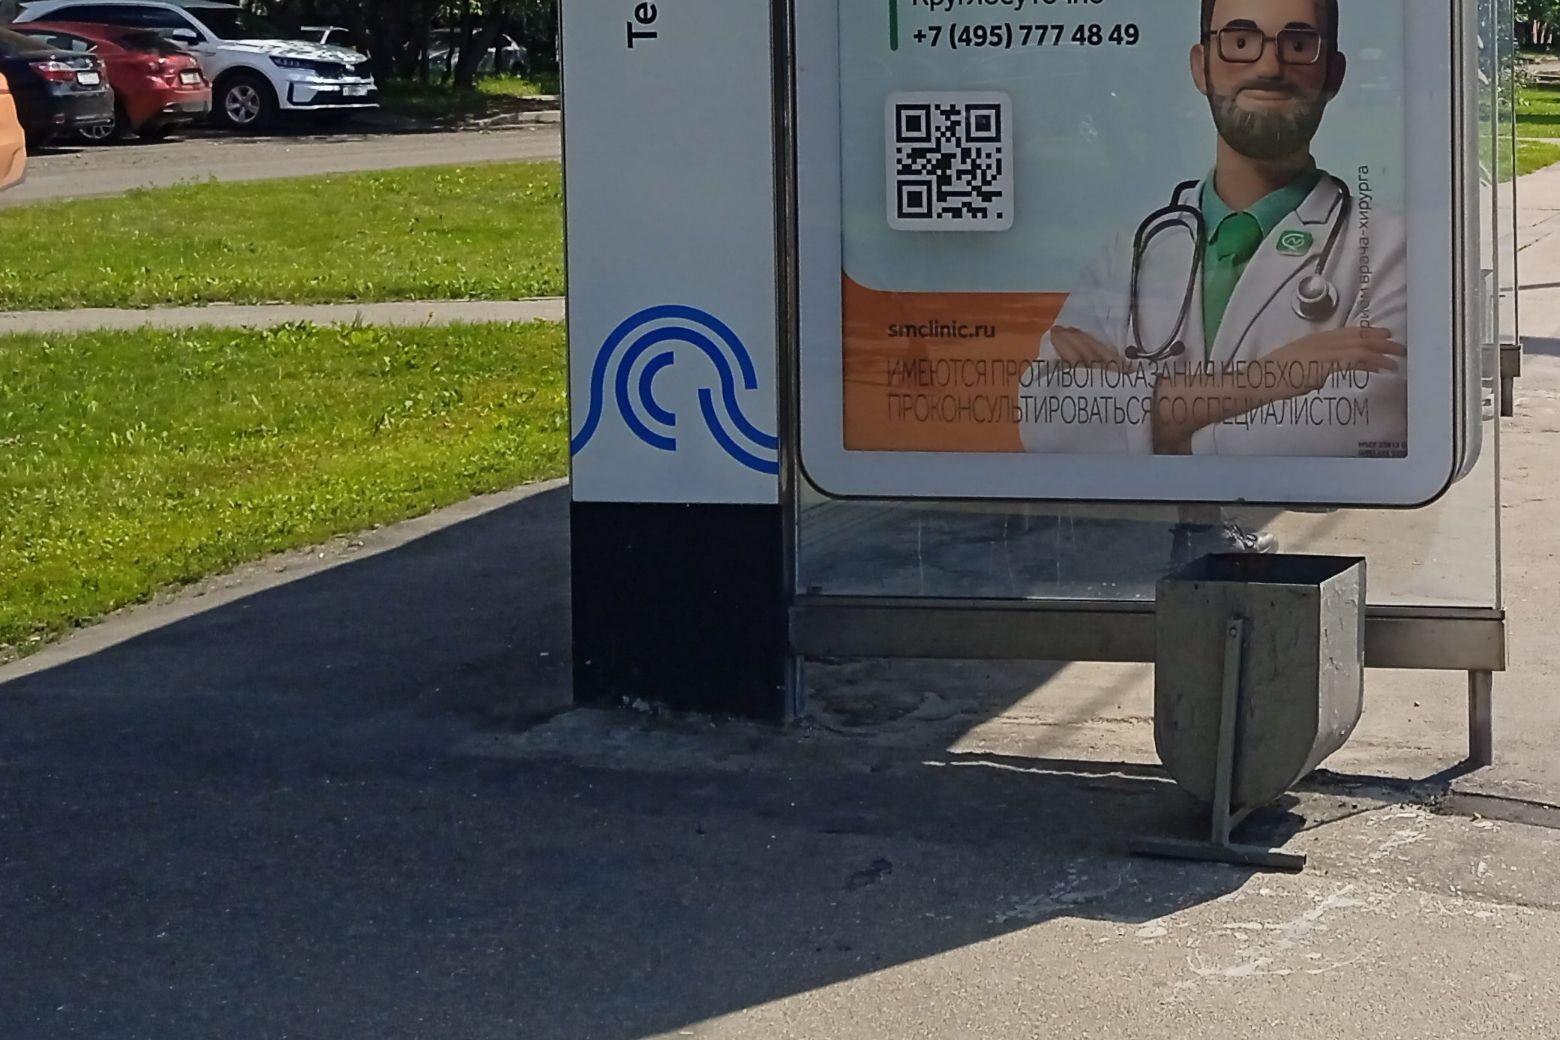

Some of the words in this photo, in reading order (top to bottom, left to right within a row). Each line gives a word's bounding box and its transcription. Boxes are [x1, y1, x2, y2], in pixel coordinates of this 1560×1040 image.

[913, 26, 942, 46] +7
[948, 23, 1014, 49] (495)
[1019, 24, 1064, 47] 777
[1071, 24, 1103, 46] 48
[1108, 24, 1140, 45] 49
[1358, 165, 1373, 284] врача-хирурга
[887, 320, 996, 342] smclinic.ru
[886, 359, 987, 388] ИМЕЮТСЯ
[886, 394, 1152, 425] ПРОКОНСУЛЬТИРОВАТЬСЯ
[1156, 396, 1188, 425] СО
[1191, 396, 1370, 431] СПЕЦИАЛИСТОМ
